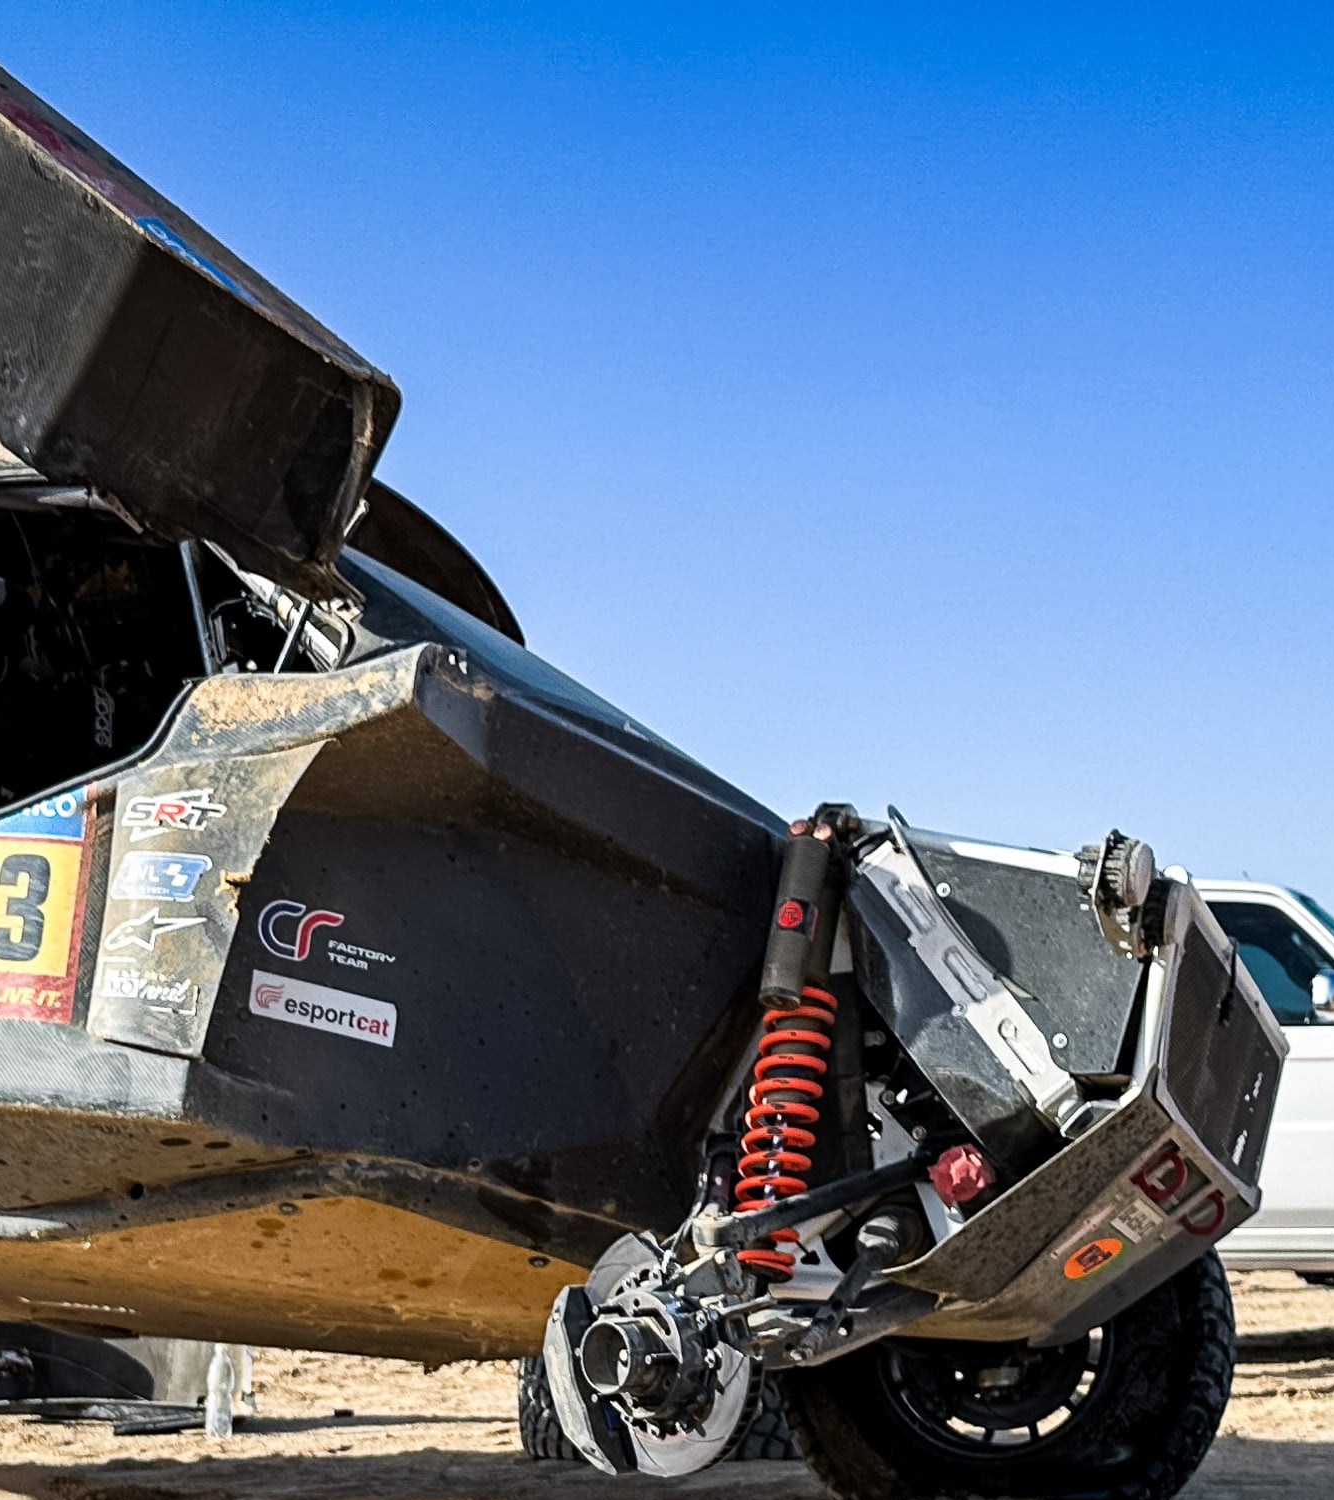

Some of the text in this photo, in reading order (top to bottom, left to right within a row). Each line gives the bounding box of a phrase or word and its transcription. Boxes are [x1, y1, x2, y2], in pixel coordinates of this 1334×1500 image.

[123, 796, 227, 831] SRT
[327, 939, 396, 963] FACTORY
[327, 951, 369, 971] TEAM
[36, 989, 62, 1009] IT.
[284, 997, 390, 1037] esportcat
